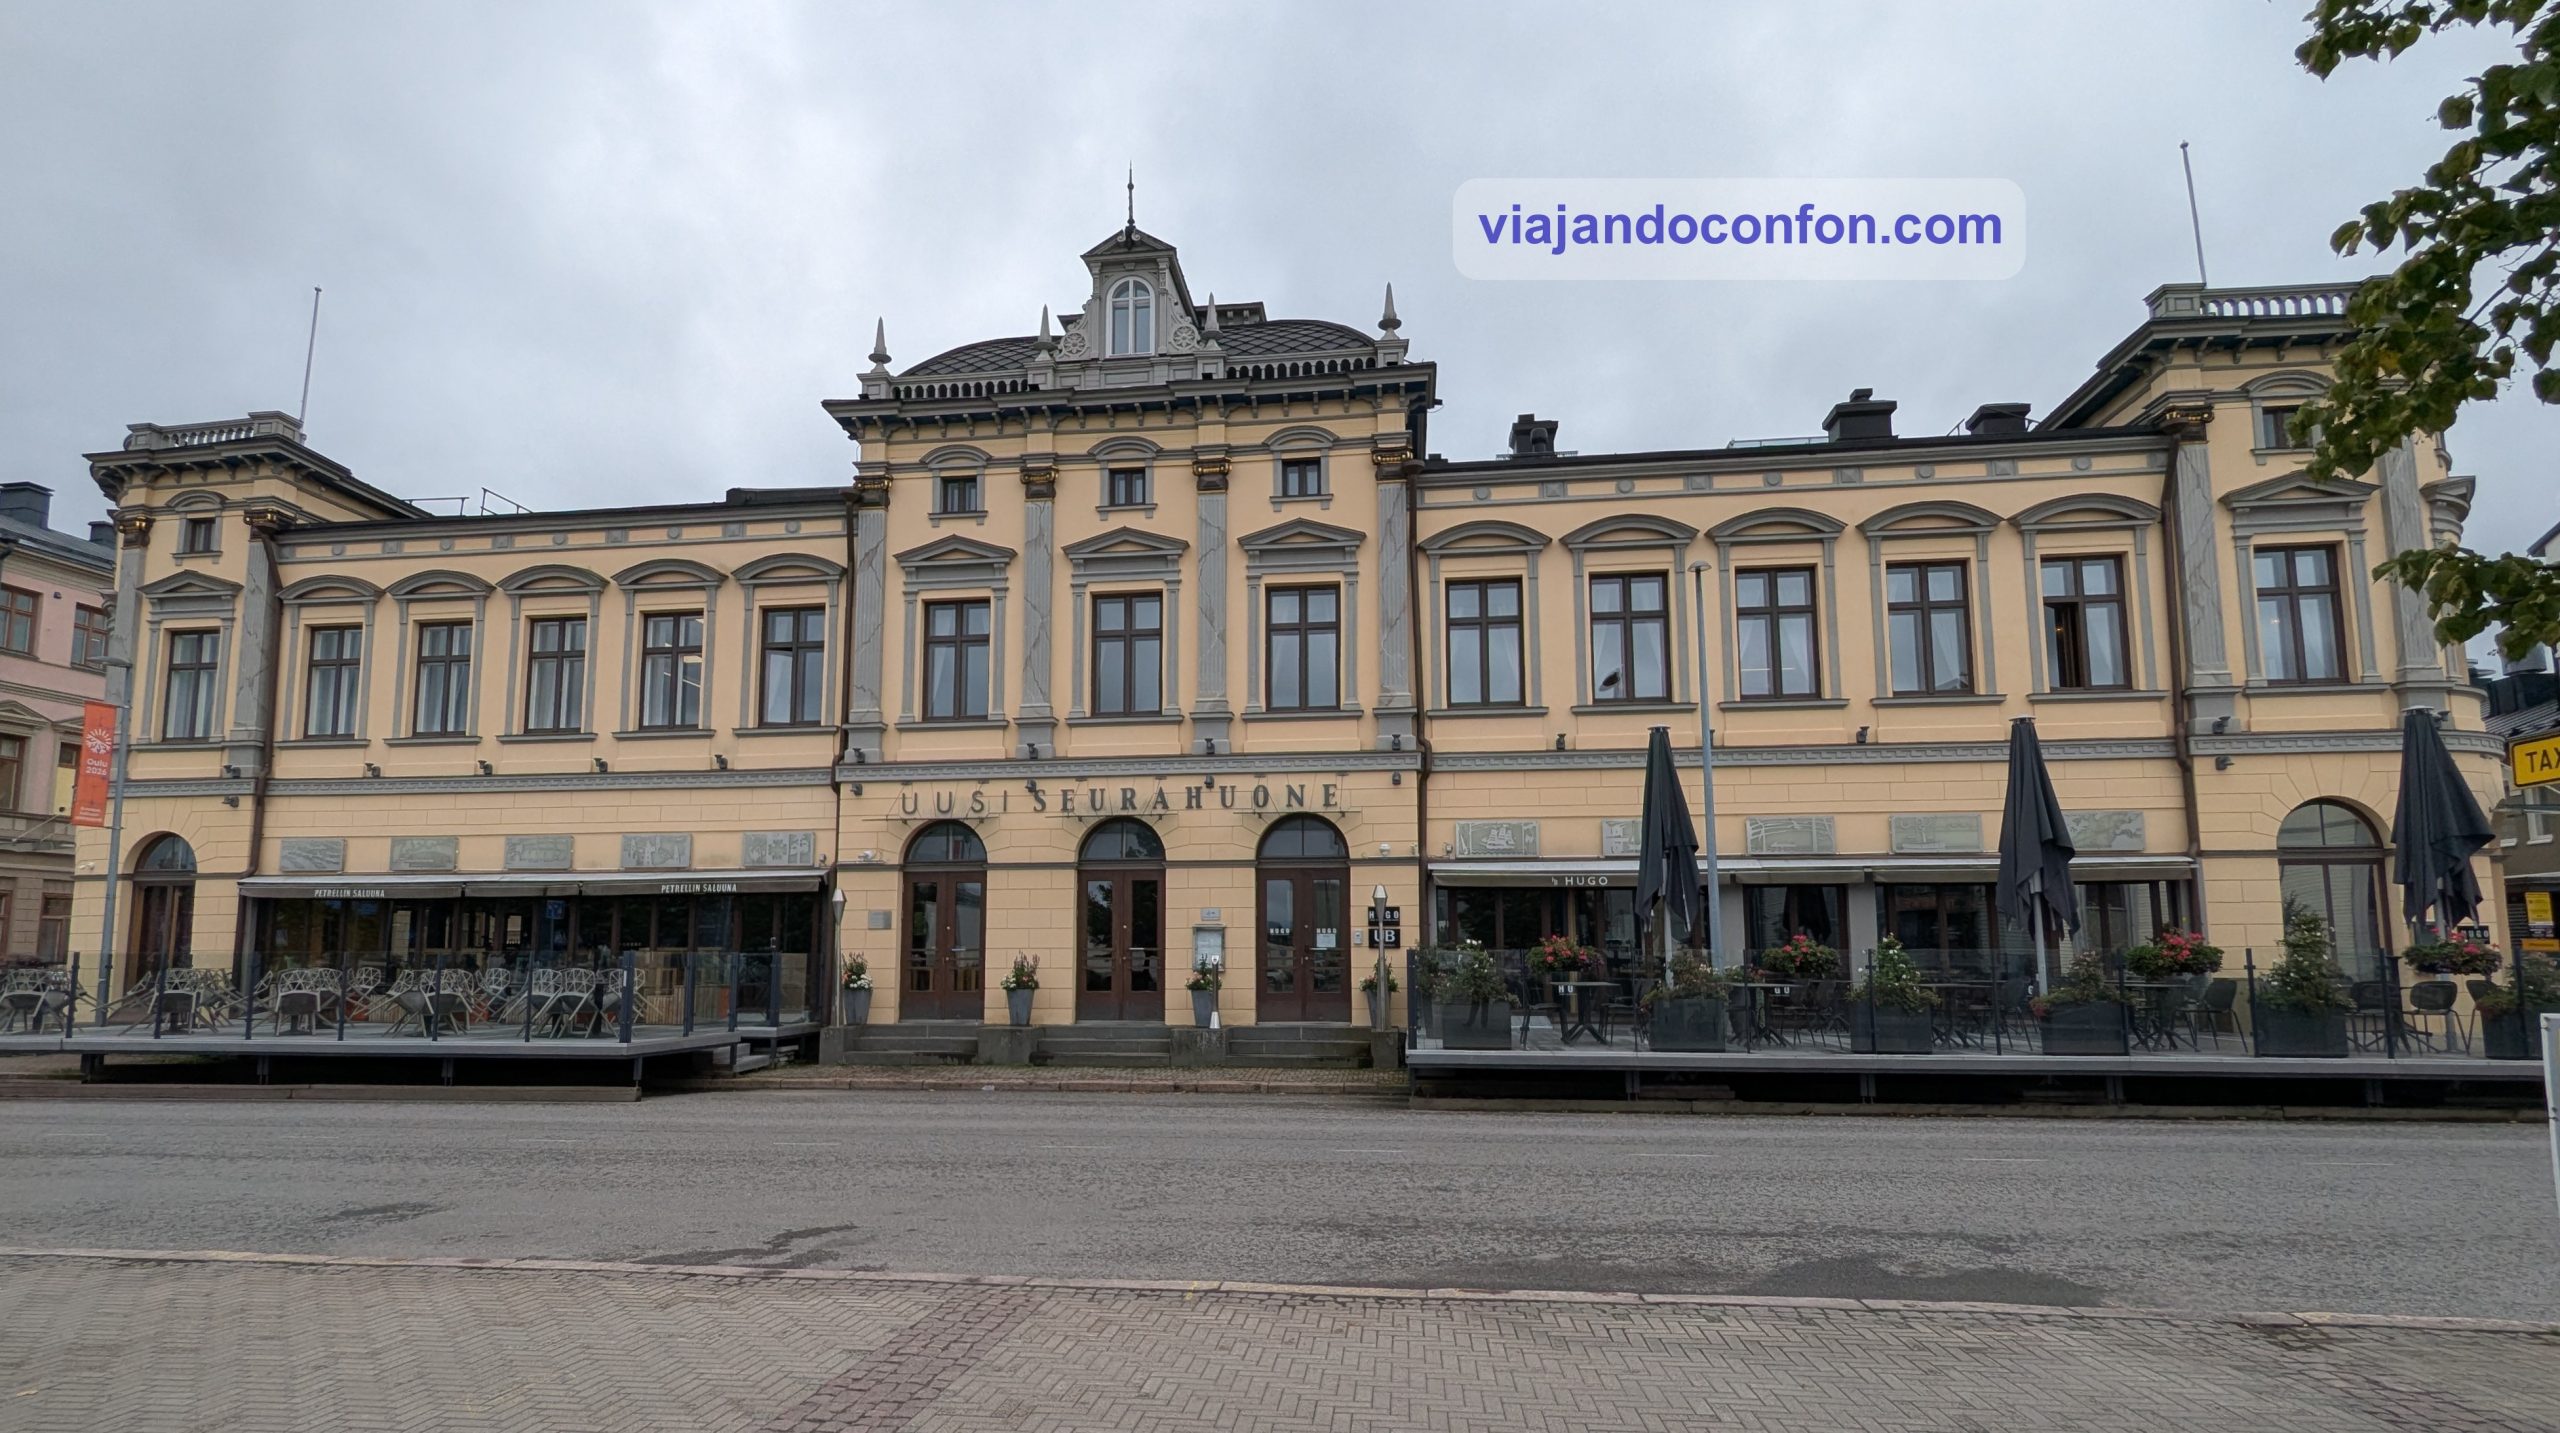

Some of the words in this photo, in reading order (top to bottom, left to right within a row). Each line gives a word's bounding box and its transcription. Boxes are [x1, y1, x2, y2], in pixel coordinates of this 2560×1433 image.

[902, 790, 1008, 815] UUSI
[1033, 784, 1338, 813] SEURAHUONE
[1565, 876, 1608, 886] HUGO
[661, 884, 701, 893] PETRELLIN
[1369, 910, 1399, 919] HGO
